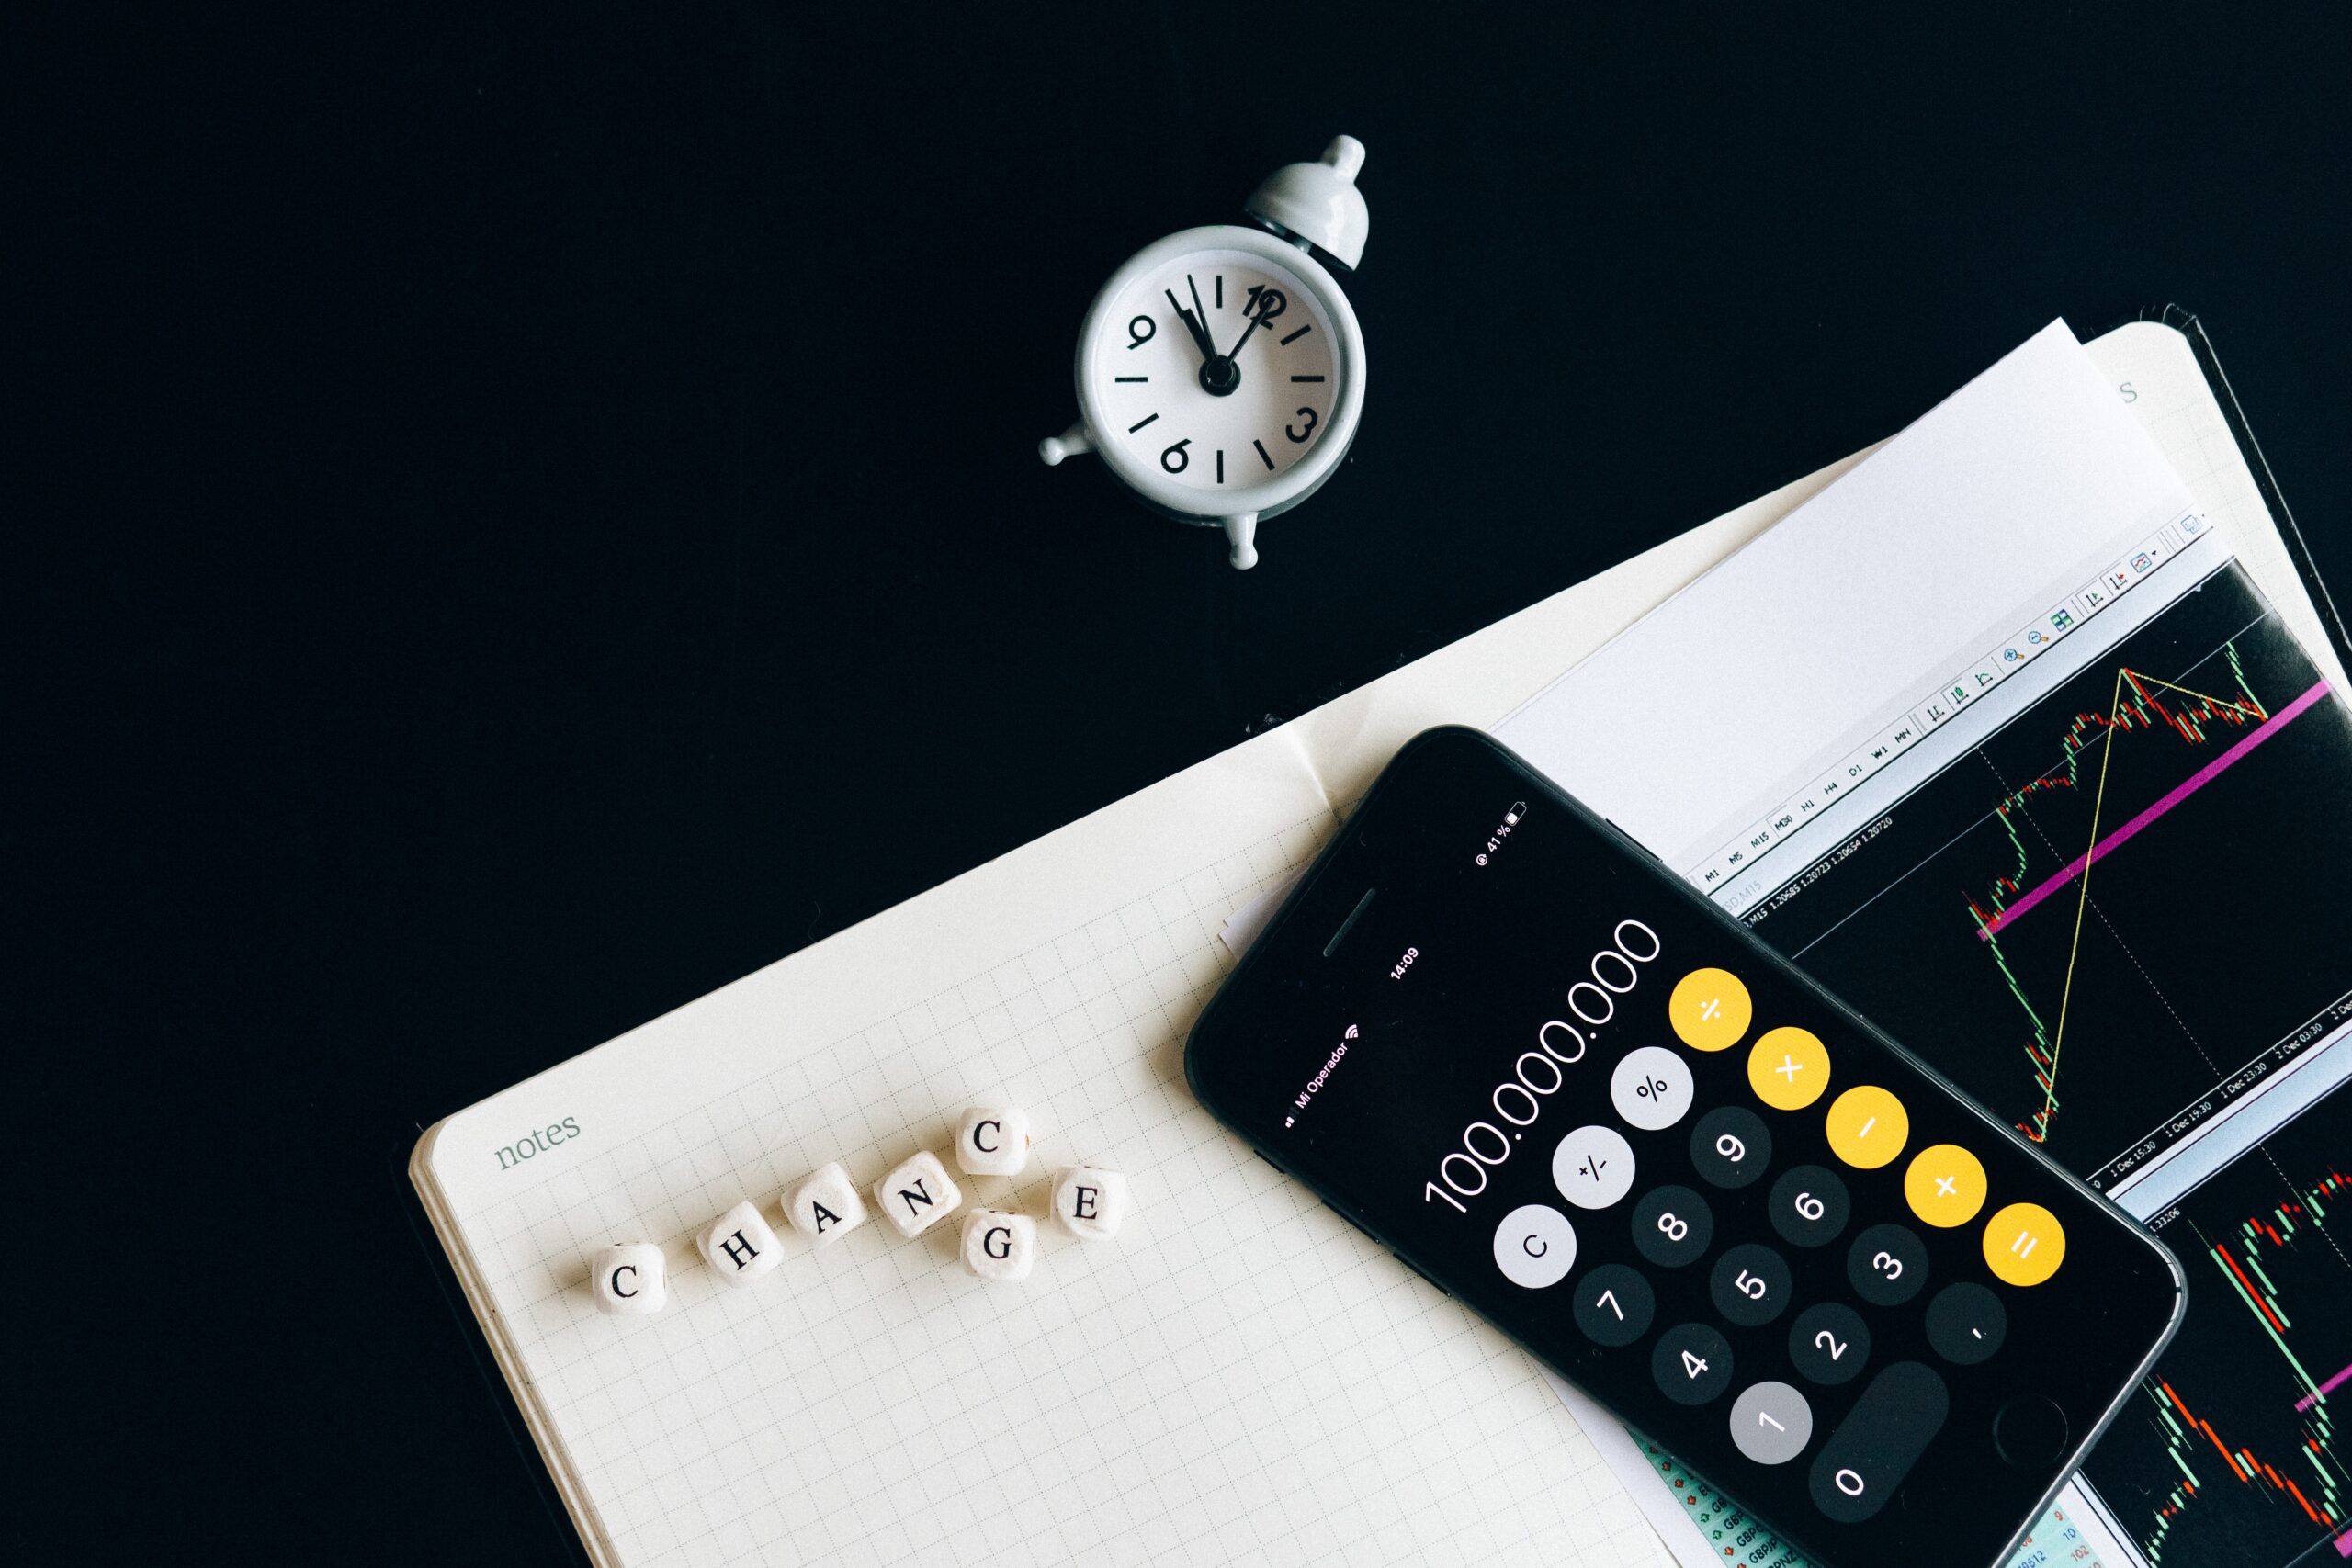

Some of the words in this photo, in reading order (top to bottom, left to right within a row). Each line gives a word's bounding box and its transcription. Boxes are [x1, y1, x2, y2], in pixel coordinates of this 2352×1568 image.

[1127, 314, 1157, 350] 9
[1285, 406, 1318, 444] 3
[1160, 438, 1193, 474] 6
[1487, 837, 1501, 852] 41
[1705, 869, 1720, 882] M1
[1728, 851, 1743, 865] M5
[1750, 831, 1770, 849] M15
[1774, 814, 1793, 831] M30
[1801, 799, 1815, 812] H1
[1824, 782, 1838, 795] H4
[1770, 883, 1801, 910] 1.20685
[1801, 861, 1831, 887] 1.20723
[1861, 816, 1893, 842] 1.20720
[1390, 947, 1419, 980] 14:09
[2282, 1040, 2301, 1055] Dec
[2299, 1022, 2323, 1043] 03:30
[1295, 1091, 1311, 1109] Mi
[1306, 1042, 1348, 1093] Operador
[1425, 919, 1661, 1213] 100.000.000
[2227, 1079, 2245, 1094] Dec
[2243, 1062, 2267, 1082] 23:30
[2172, 1118, 2189, 1133] Dec
[2188, 1101, 2211, 1122] 19:30
[493, 1115, 582, 1171] notes
[1715, 1134, 1746, 1162] 9
[2117, 1156, 2134, 1172] Dec
[2133, 1140, 2156, 1160] 15:30
[1794, 1192, 1825, 1221] 6
[1657, 1213, 1688, 1241] 8
[1522, 1234, 1548, 1258] C
[1872, 1251, 1903, 1280] 3
[1735, 1269, 1766, 1300] 5
[1596, 1290, 1624, 1321] 7
[1815, 1330, 1848, 1361] 2
[1681, 1350, 1709, 1380] 4
[1758, 1411, 1785, 1432] 1
[1835, 1469, 1864, 1496] 0
